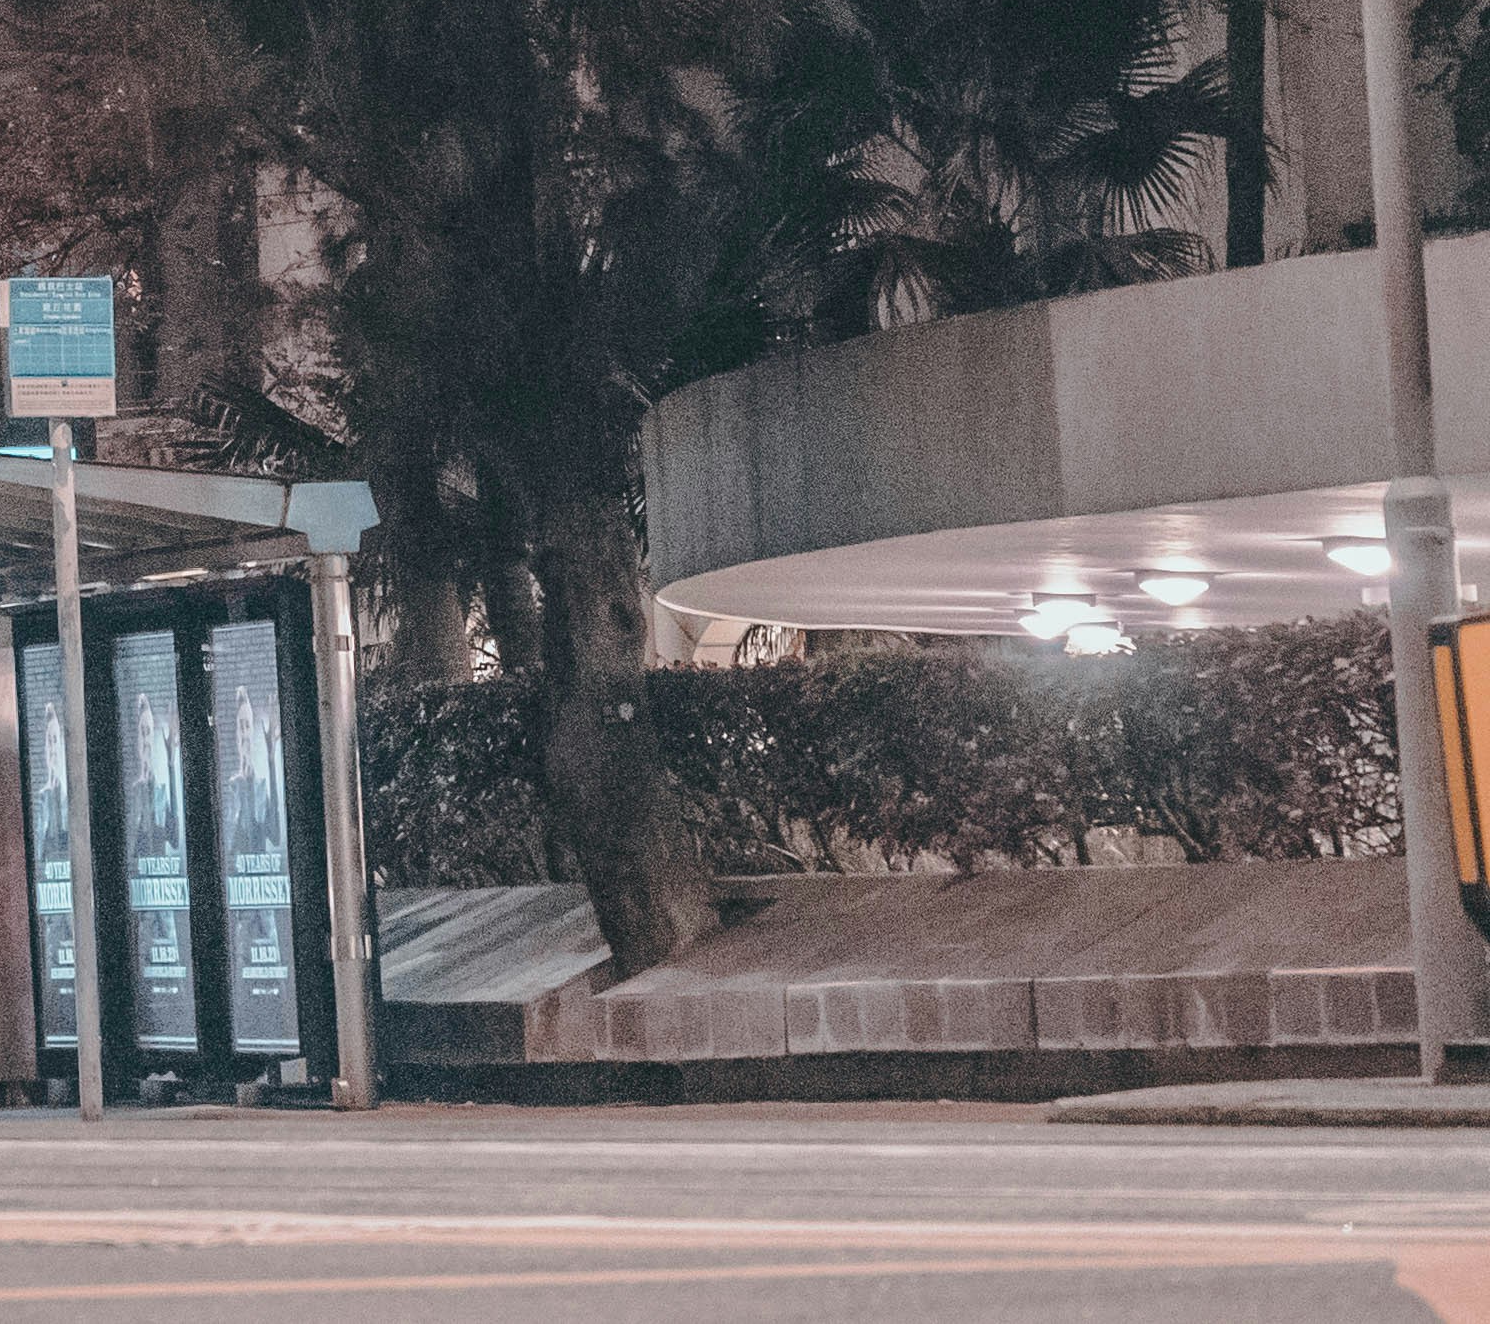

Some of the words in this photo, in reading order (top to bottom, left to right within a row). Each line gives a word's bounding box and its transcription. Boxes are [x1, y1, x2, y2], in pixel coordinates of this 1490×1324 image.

[146, 856, 170, 875] YEARS
[170, 856, 181, 875] OF
[245, 853, 270, 873] YEARS
[270, 853, 281, 872] OF
[131, 877, 190, 906] MORRISSEY
[227, 875, 291, 905] MORRISSEY
